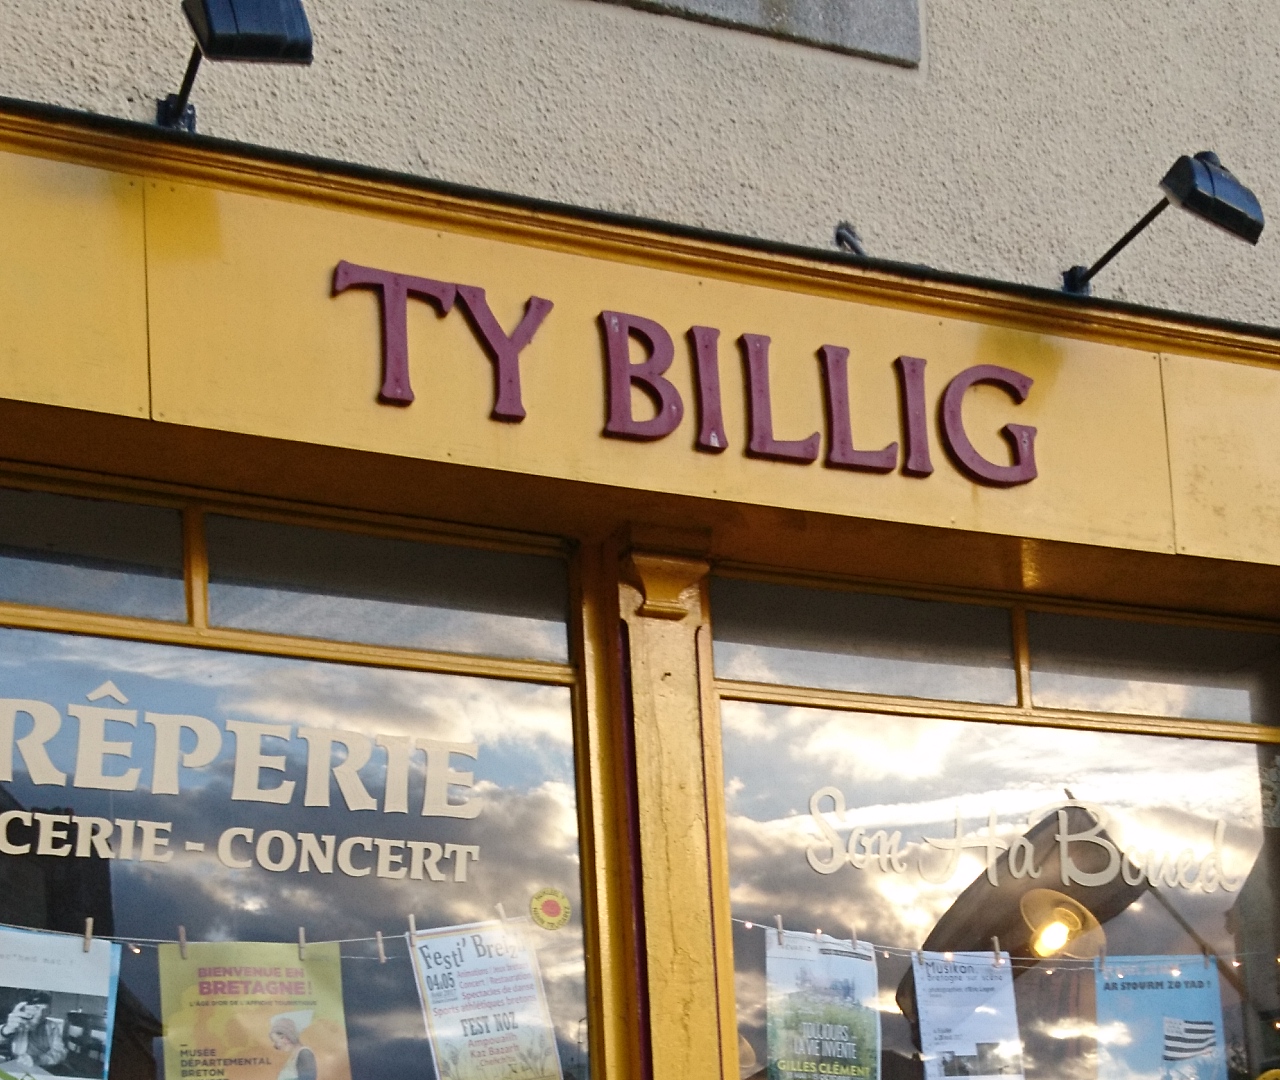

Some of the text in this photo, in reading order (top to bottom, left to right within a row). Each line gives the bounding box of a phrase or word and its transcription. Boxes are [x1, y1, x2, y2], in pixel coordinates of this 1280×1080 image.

[330, 259, 1038, 489] TY BILLIG
[806, 785, 908, 875] Son
[919, 805, 1043, 888] Ha
[219, 825, 480, 884] CONCERT
[198, 967, 304, 978] BIENVENUE EN
[459, 978, 485, 989] Concert
[489, 971, 533, 984] Restauration
[198, 980, 306, 996] BRETAGNE
[462, 982, 535, 1000] Spectacles de danse
[1103, 981, 1118, 991] AR
[1120, 980, 1164, 991] STOURM
[432, 1005, 460, 1018] Sports
[460, 1011, 519, 1037] FEST NOZ
[180, 1047, 216, 1057] MUSÉE
[821, 1040, 857, 1059] INVENTE
[180, 1057, 272, 1068] DÉPARTEMENTAL
[777, 1059, 870, 1077] GILLES CLÉMENT
[181, 1068, 225, 1078] BRETON
